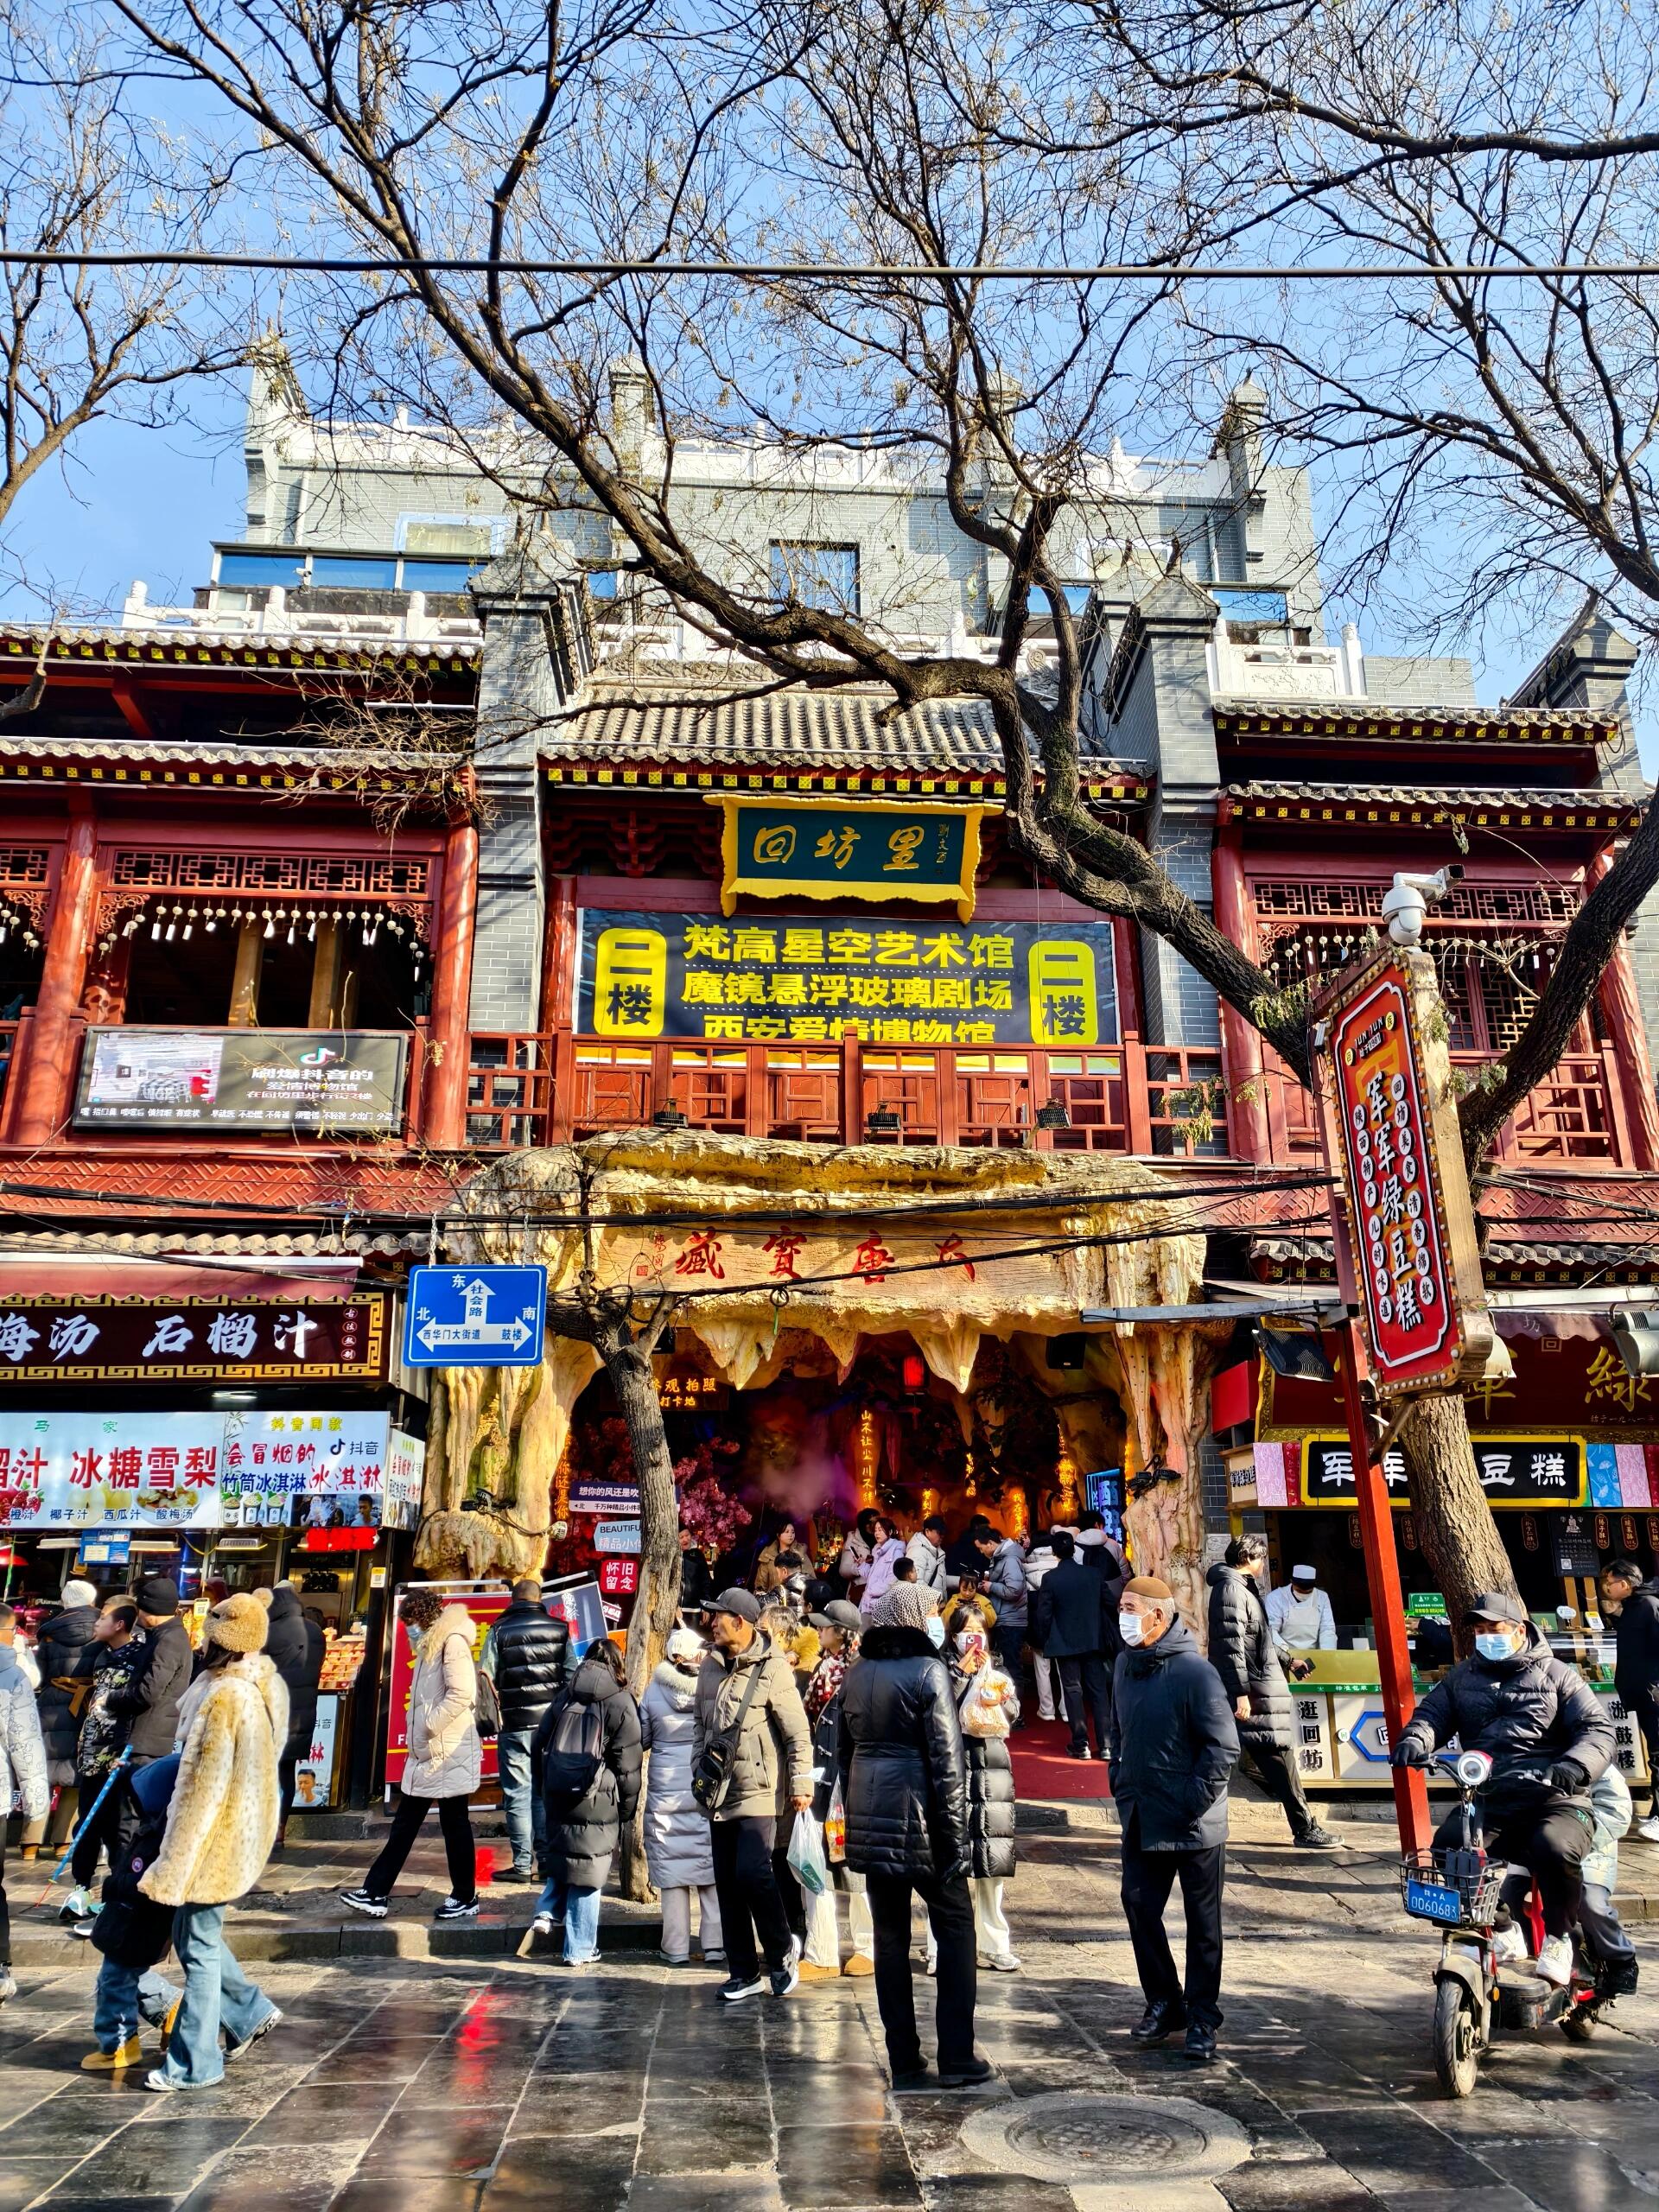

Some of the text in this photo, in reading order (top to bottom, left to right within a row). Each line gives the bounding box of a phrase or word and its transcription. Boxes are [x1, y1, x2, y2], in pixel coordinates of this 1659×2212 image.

[753, 824, 925, 870] 回坊里
[683, 924, 1014, 969] 梵高星空艺术馆
[606, 942, 653, 1026] 二楼
[681, 970, 1013, 1010] 魔镜悬浮玻璃剧场
[1041, 953, 1087, 1036] 二楼
[703, 1014, 995, 1043] 西安爱情博物馆
[1354, 1017, 1383, 1048] JUN JUN
[251, 1067, 374, 1080] 刷爆抖音的
[1392, 1077, 1414, 1179] 回坊美食
[1354, 1109, 1374, 1201] 陕西特产
[1365, 1071, 1422, 1332] 军军绿豆糕
[1408, 1194, 1433, 1300] 清香绵软
[451, 1274, 467, 1288] 东
[1370, 1221, 1390, 1317] 儿时味道
[416, 1306, 431, 1321] 北
[468, 1285, 484, 1317] 社会路
[522, 1306, 537, 1321] 南
[142, 1311, 318, 1360] 石榴汁
[423, 1328, 481, 1340] 西华门大街道
[500, 1328, 523, 1341] 鼓楼
[659, 1395, 696, 1408] 打卡地
[271, 1416, 343, 1432] 抖音同款
[226, 1442, 316, 1466] 会冒烟的
[349, 1440, 379, 1456] 抖音
[69, 1446, 218, 1489] 冰糖雪梨
[308, 1464, 384, 1493] 冰淇淋
[1321, 1452, 1567, 1487] 军军豆糕
[221, 1472, 307, 1493] 竹筒冰淇淋
[579, 1486, 639, 1498] 想你的风还是吹
[50, 1509, 88, 1521] 椰子汁
[104, 1509, 142, 1522] 西瓜汁
[156, 1509, 194, 1521] 酸梅汤
[594, 1503, 641, 1513] 千万种精品小件
[606, 1561, 634, 1576] 怀旧
[606, 1576, 634, 1590] 留念
[1298, 1700, 1324, 1771] 逛回坊
[1609, 1700, 1636, 1770] 游鼓楼
[1411, 1896, 1458, 1919] 0060683
